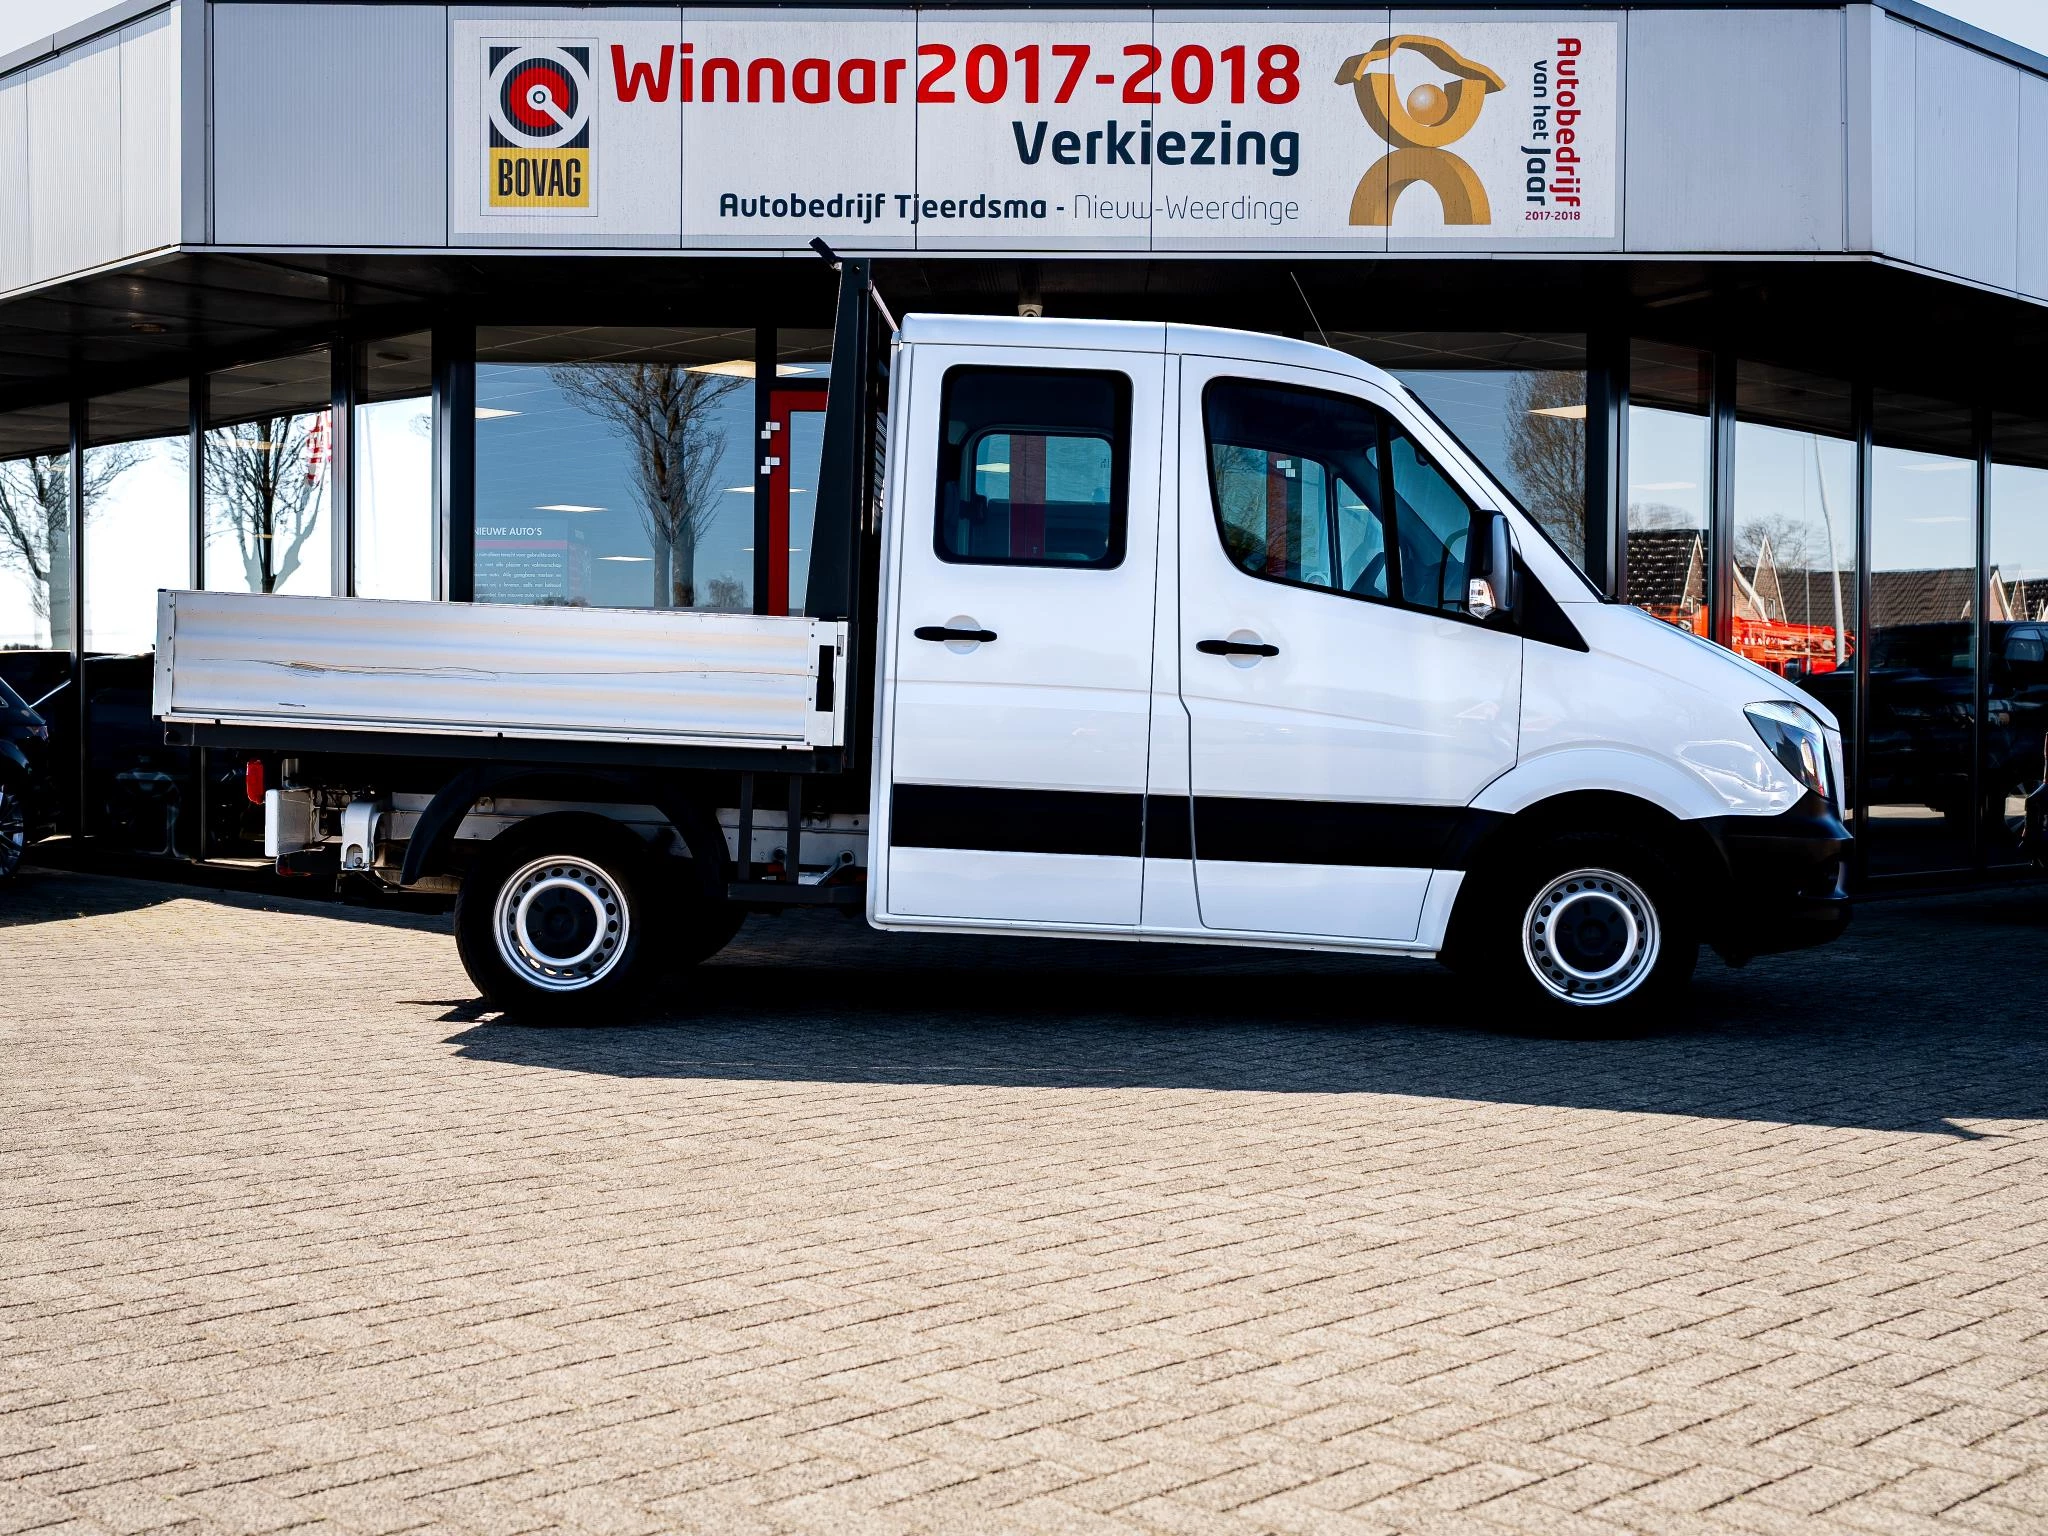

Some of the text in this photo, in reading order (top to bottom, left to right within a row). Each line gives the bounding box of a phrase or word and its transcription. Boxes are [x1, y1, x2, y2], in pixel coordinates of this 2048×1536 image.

[610, 43, 1301, 105] Winnaar 2017-2018
[1532, 60, 1549, 99] van
[1532, 104, 1551, 140] het
[1548, 37, 1582, 207] Autobedrijf
[1012, 119, 1300, 177] Verkiezing
[497, 157, 581, 197] BOVAG
[720, 193, 886, 224] Autobedrijf
[894, 194, 1047, 224] Tjeerdsma
[1074, 194, 1299, 226] Nieuw-Weerdinge
[1524, 210, 1581, 221] 2017-2018
